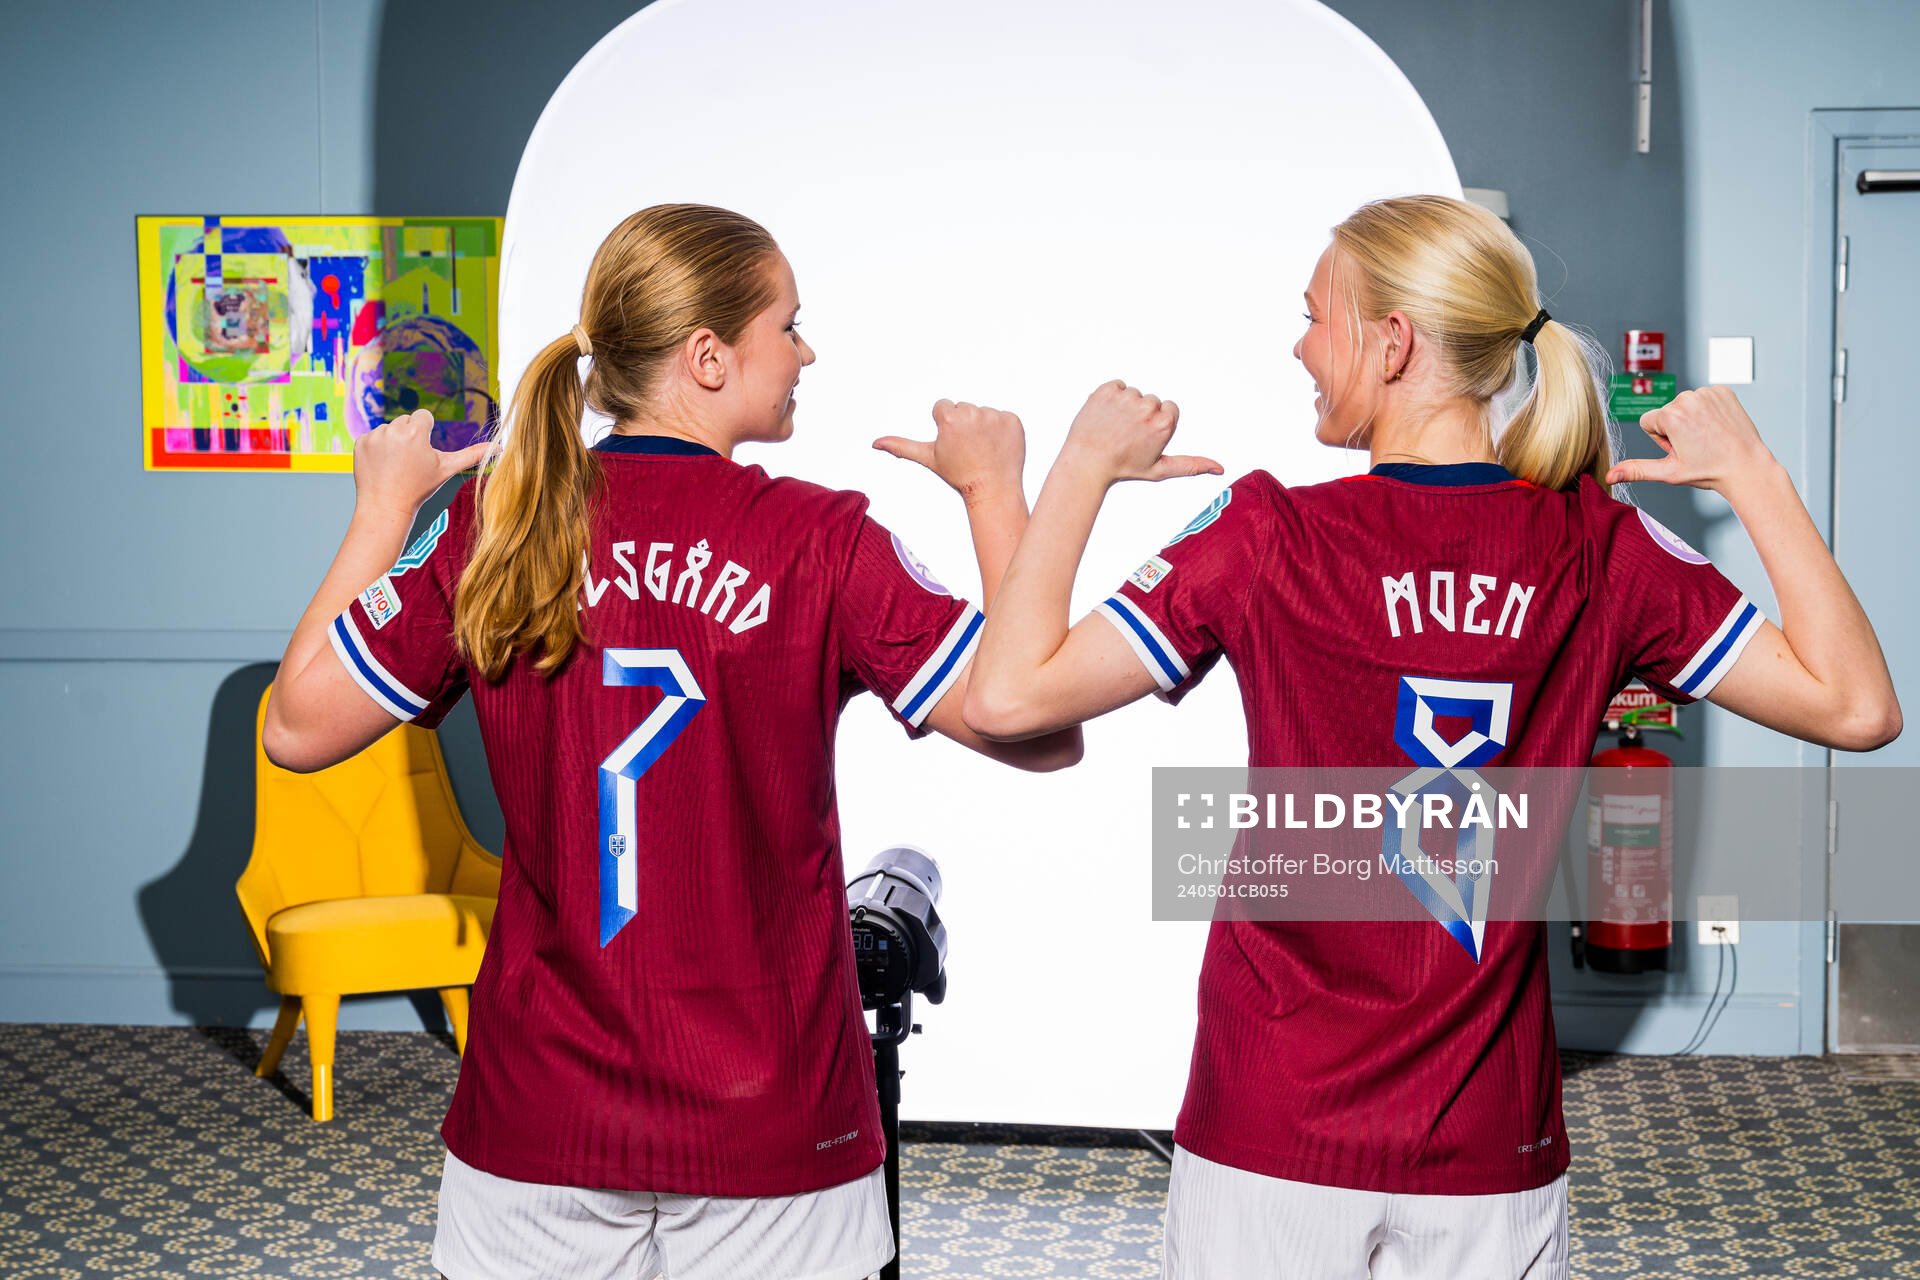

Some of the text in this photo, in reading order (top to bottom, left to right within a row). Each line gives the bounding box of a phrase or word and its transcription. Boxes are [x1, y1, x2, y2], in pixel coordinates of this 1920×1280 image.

[577, 539, 771, 634] LSGÅRD
[1381, 571, 1536, 639] MOEN
[598, 648, 707, 949] 7
[1381, 674, 1515, 965] 8
